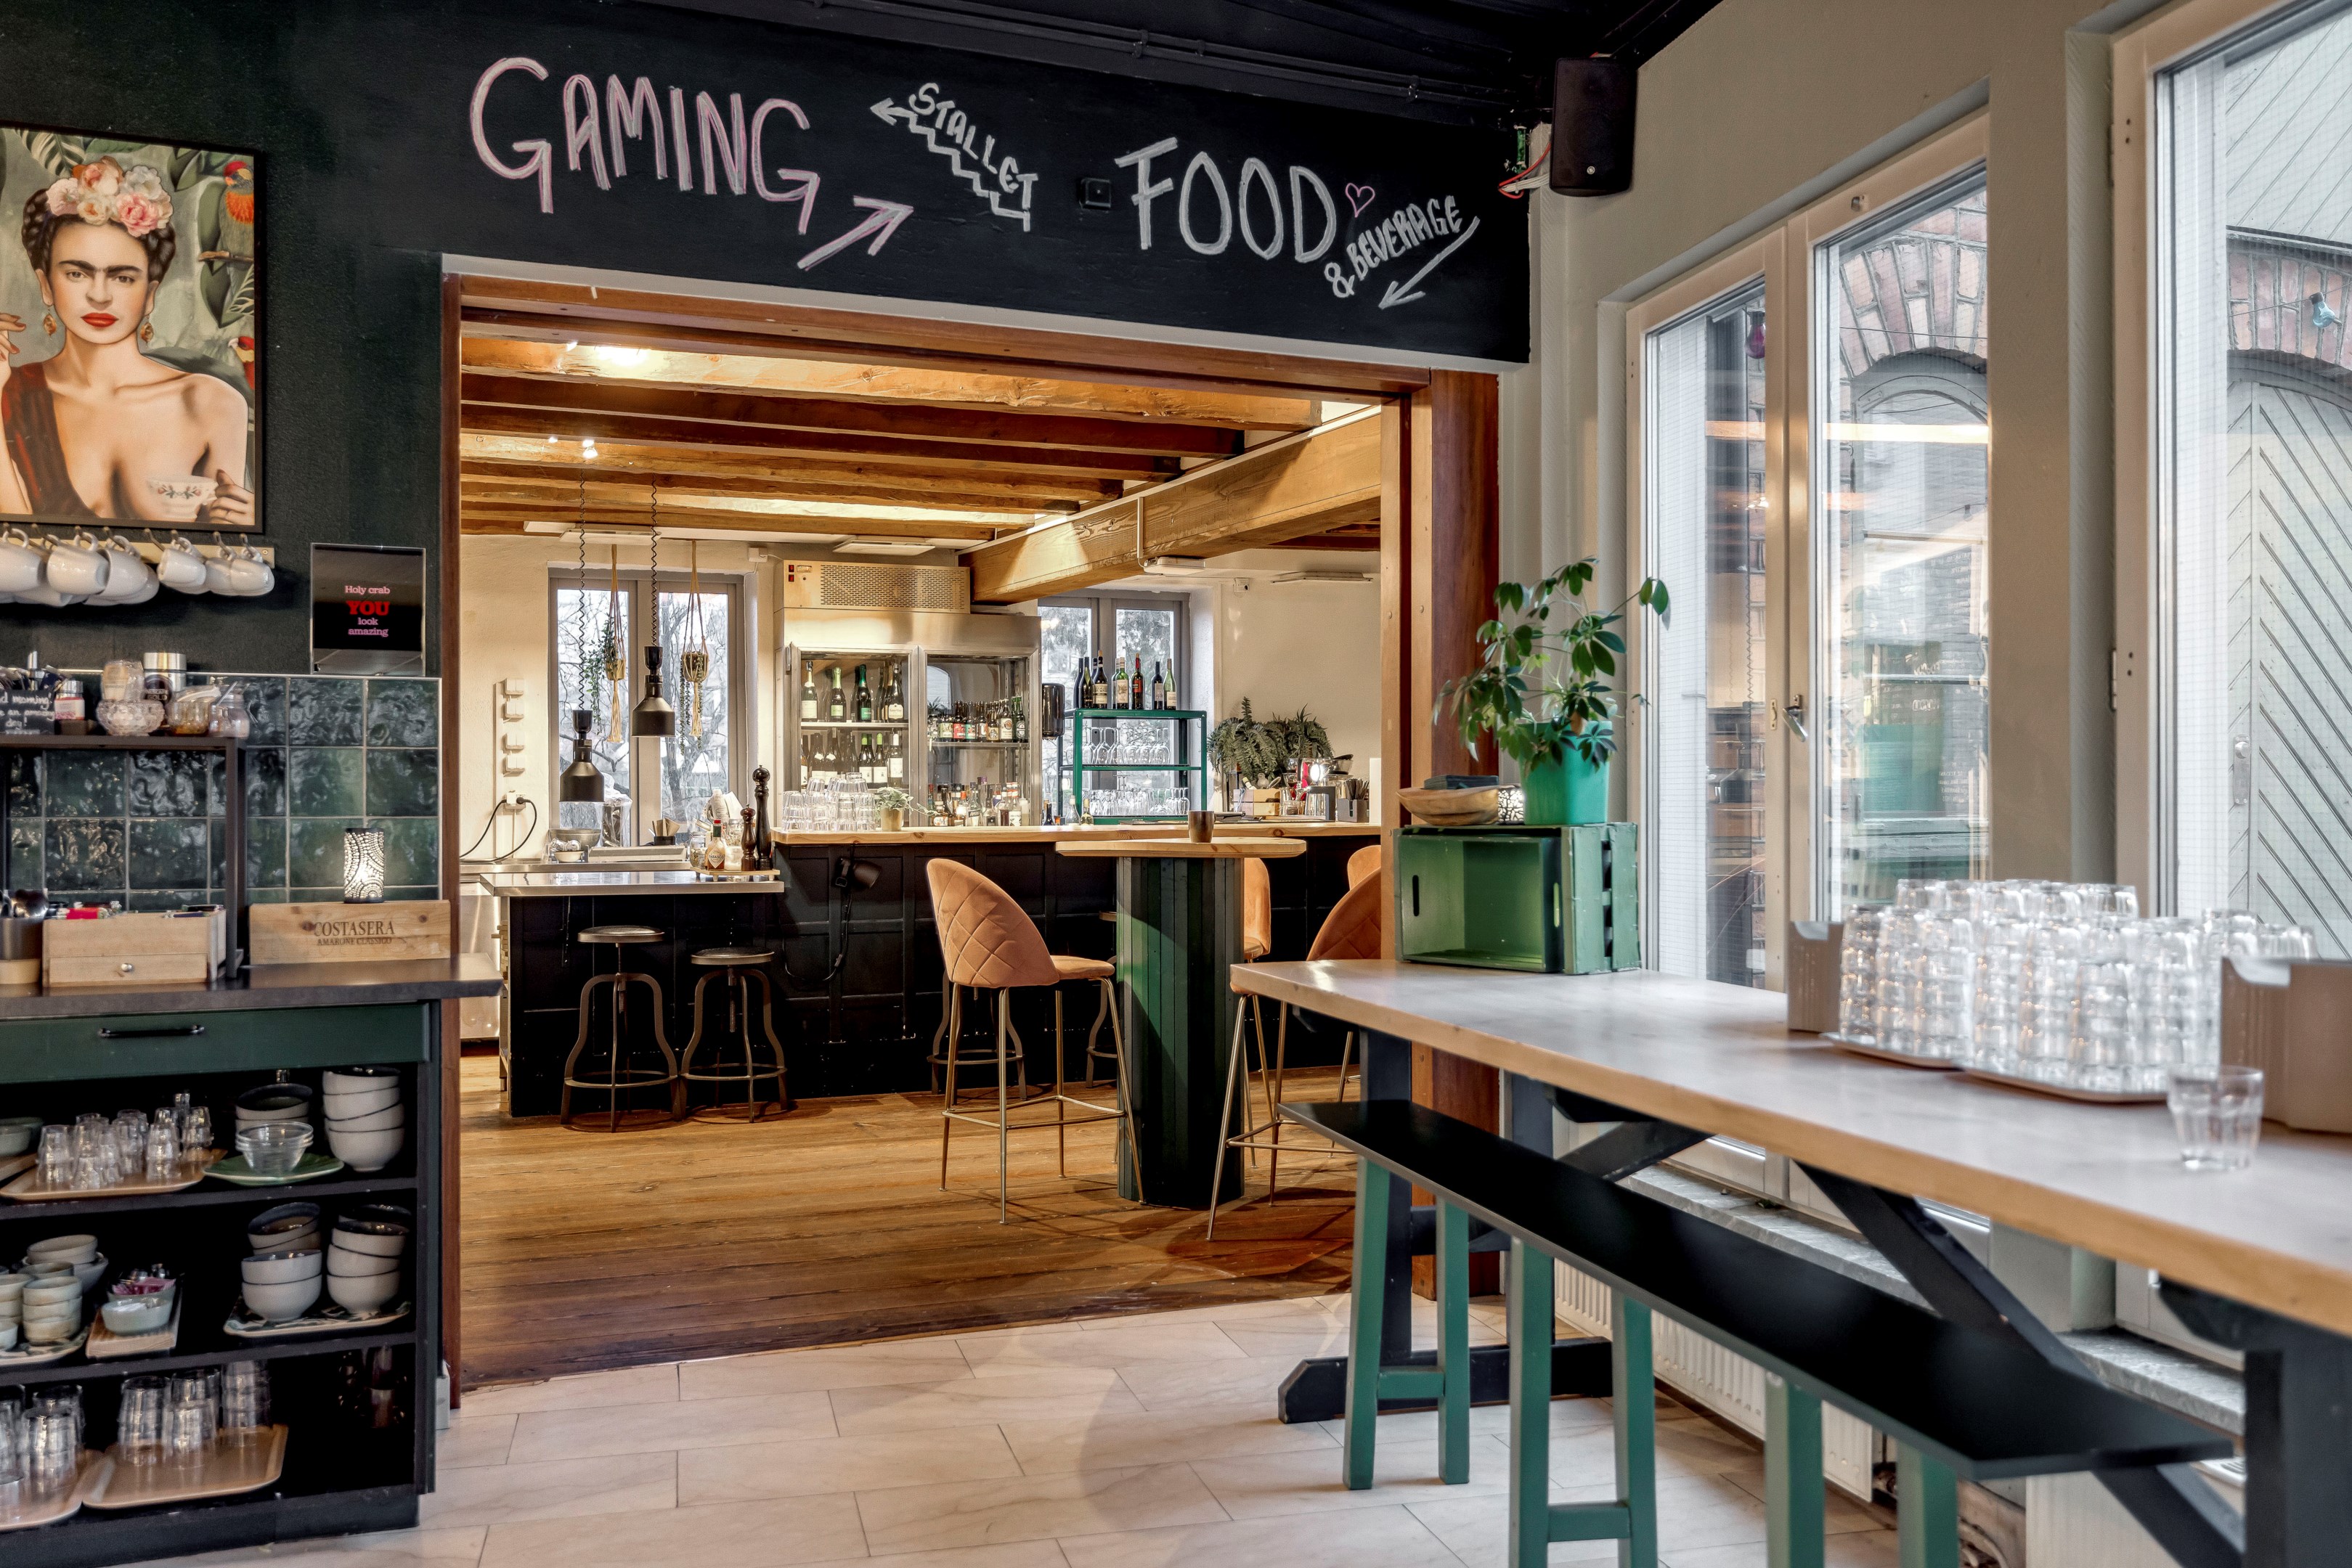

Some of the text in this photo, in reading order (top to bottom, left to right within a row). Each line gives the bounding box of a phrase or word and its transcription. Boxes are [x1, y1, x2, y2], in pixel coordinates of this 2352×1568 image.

[470, 57, 821, 235] GAMING
[908, 82, 1040, 211] STALLET
[1114, 136, 1338, 264] FOOD
[1349, 195, 1463, 281] BEVERAGE
[344, 585, 367, 595] Holy
[346, 600, 391, 616] YOU
[348, 627, 389, 637] amazing
[314, 920, 395, 937] COSTASERA
